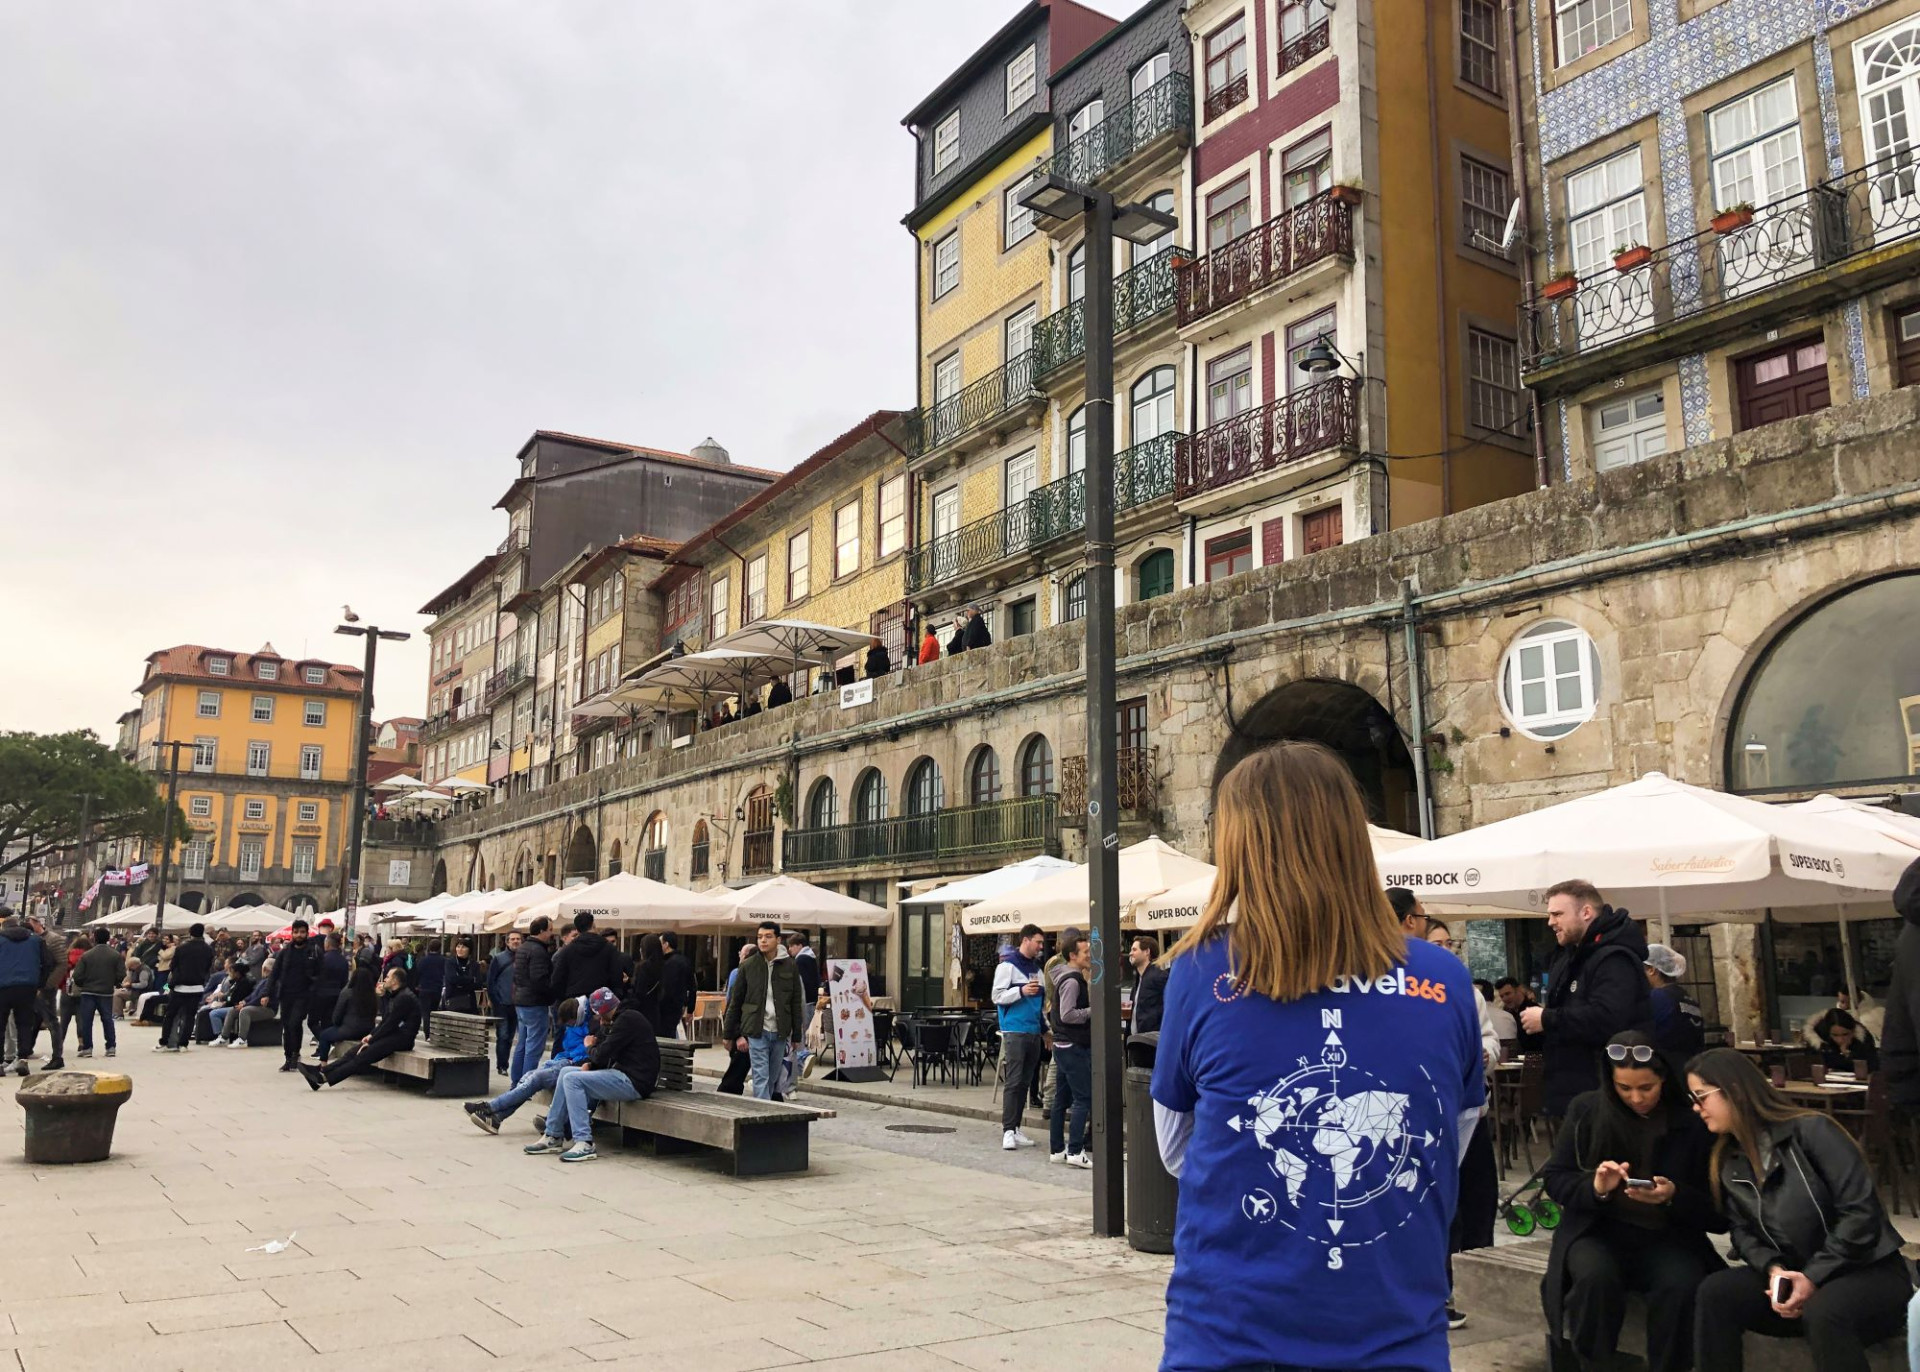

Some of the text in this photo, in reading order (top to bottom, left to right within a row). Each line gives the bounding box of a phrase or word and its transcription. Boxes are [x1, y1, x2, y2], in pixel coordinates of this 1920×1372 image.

[1614, 378, 1625, 389] 35
[1789, 853, 1813, 869] SUPER
[1814, 858, 1834, 873] BOCK
[1386, 872, 1459, 886] SUPER BOCK
[969, 915, 991, 926] SUPER
[991, 913, 1011, 924] BOCK
[1148, 908, 1173, 920] SUPER
[1174, 906, 1198, 918] BOCK
[1312, 968, 1447, 1003] avel365
[1321, 1008, 1343, 1029] N
[1327, 1247, 1343, 1270] S
